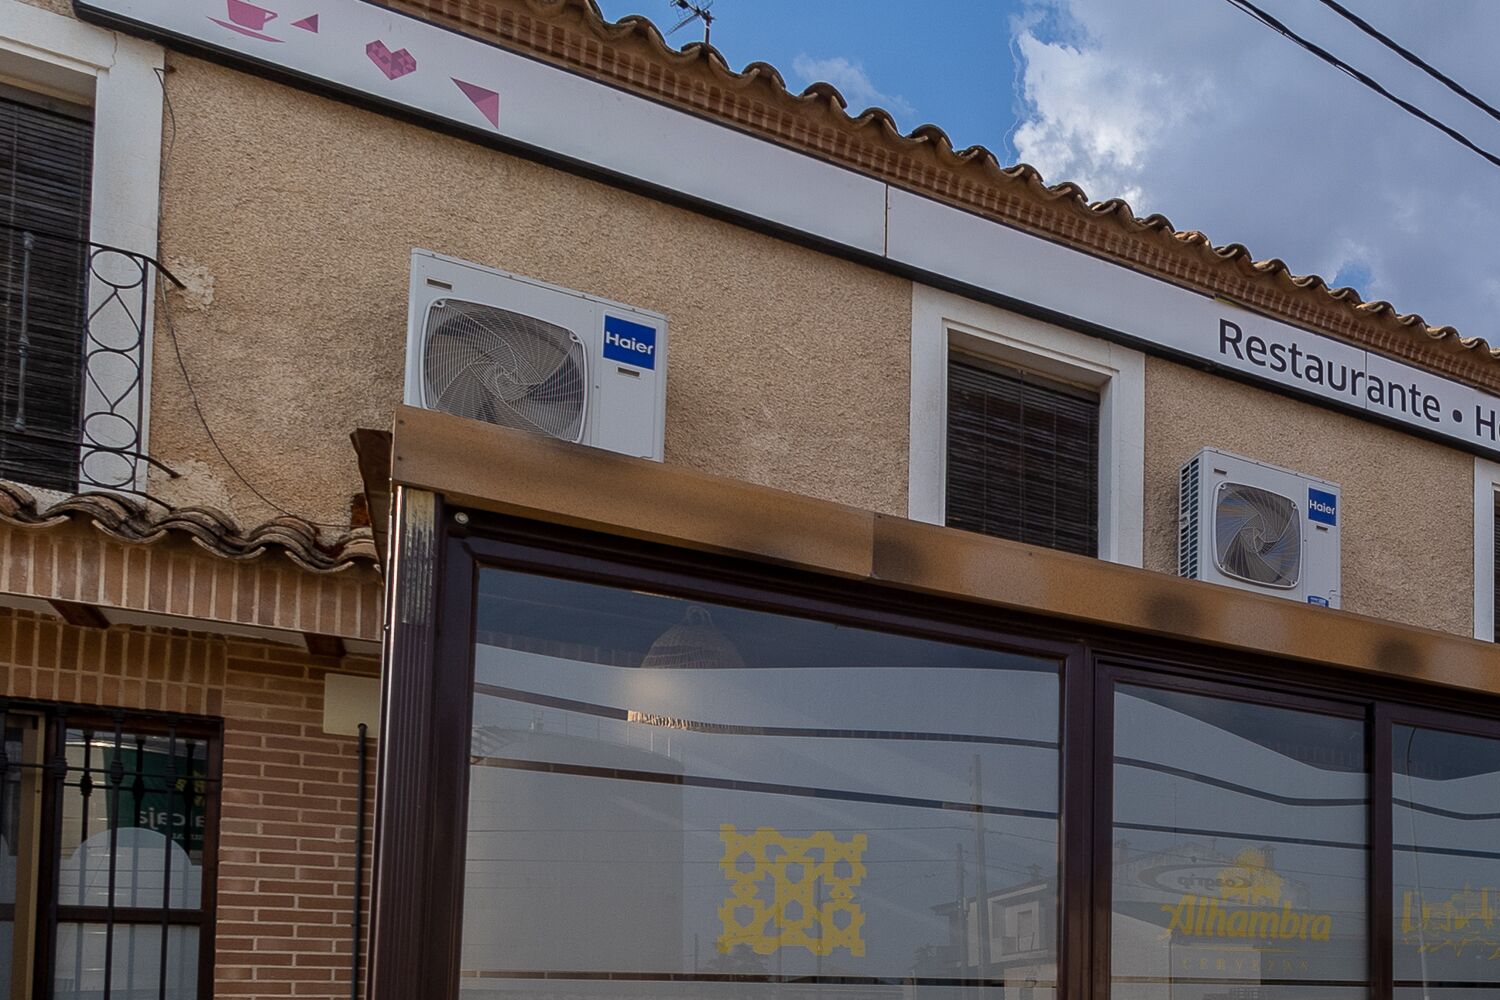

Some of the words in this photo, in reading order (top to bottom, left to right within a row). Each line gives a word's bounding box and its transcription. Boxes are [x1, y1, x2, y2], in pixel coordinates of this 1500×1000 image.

[606, 331, 654, 355] Haier
[1219, 318, 1441, 423] Restaurante
[1309, 500, 1335, 515] Haier
[1159, 892, 1333, 943] Alhambra
